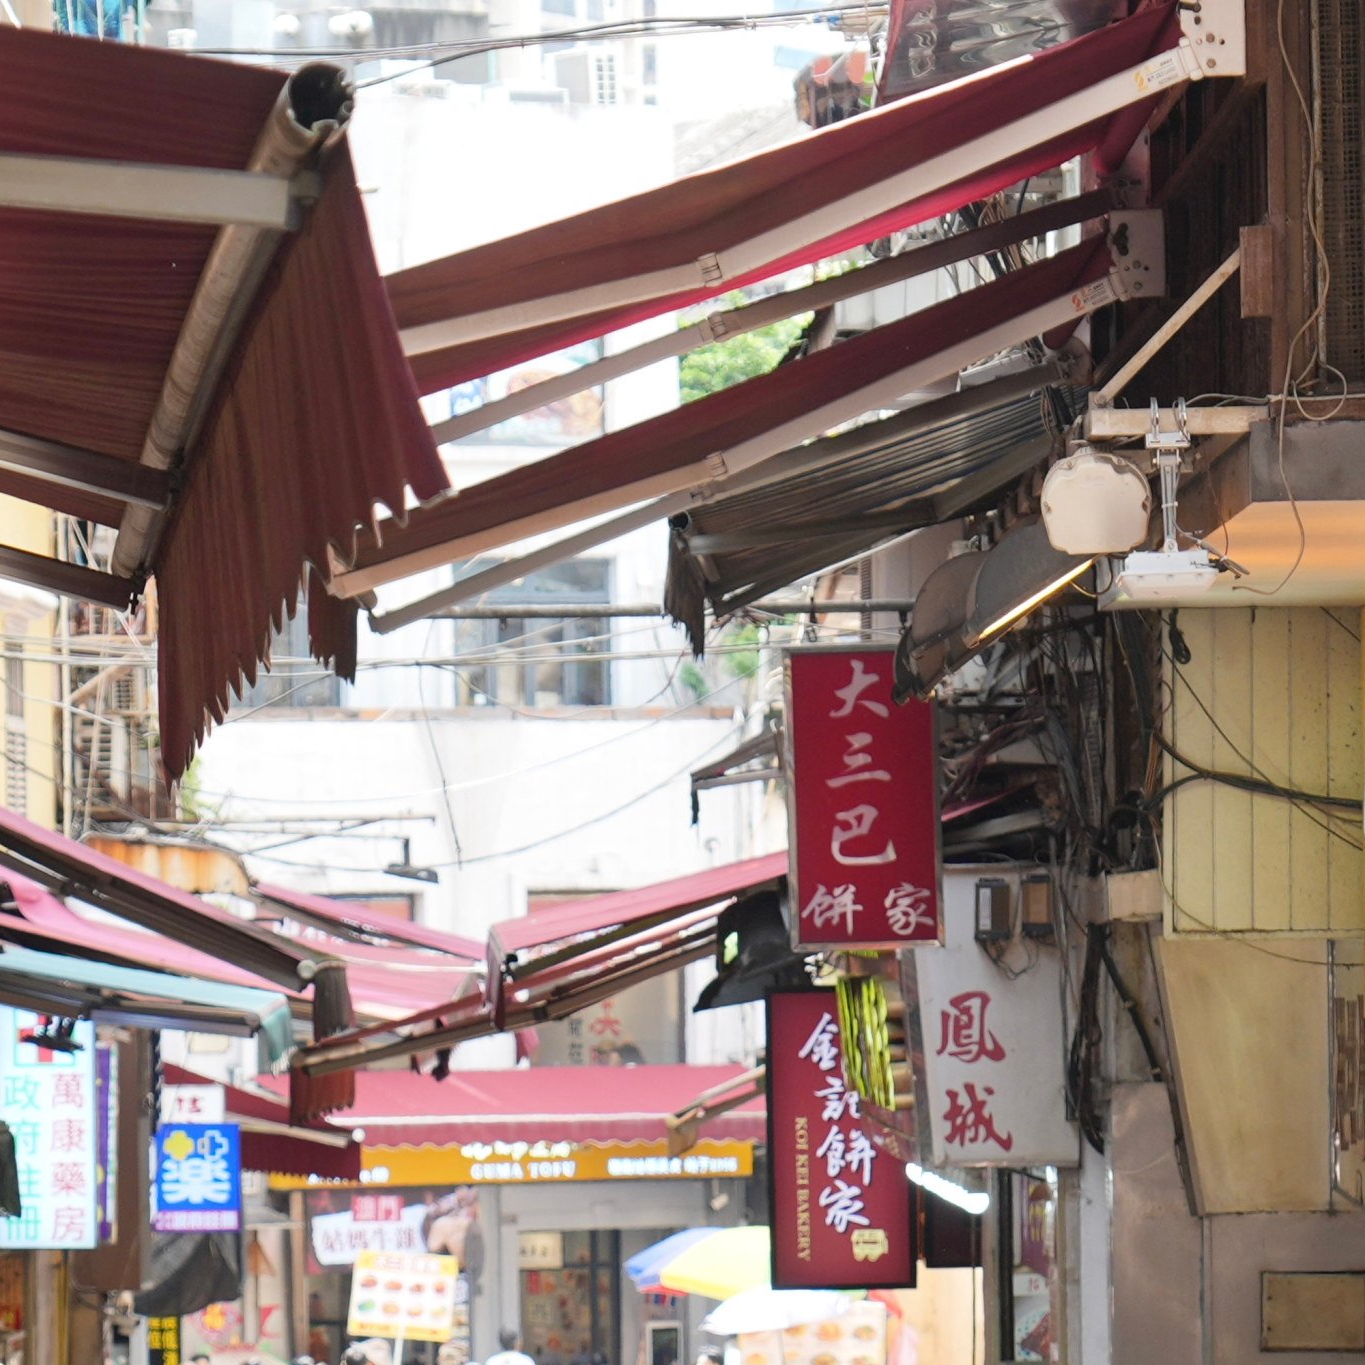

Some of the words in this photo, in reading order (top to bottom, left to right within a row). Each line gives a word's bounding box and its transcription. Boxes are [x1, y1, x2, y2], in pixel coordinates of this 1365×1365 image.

[826, 659, 896, 864] 大三巴
[800, 882, 936, 935] 餅家
[50, 1073, 87, 1242] 萬康藥房
